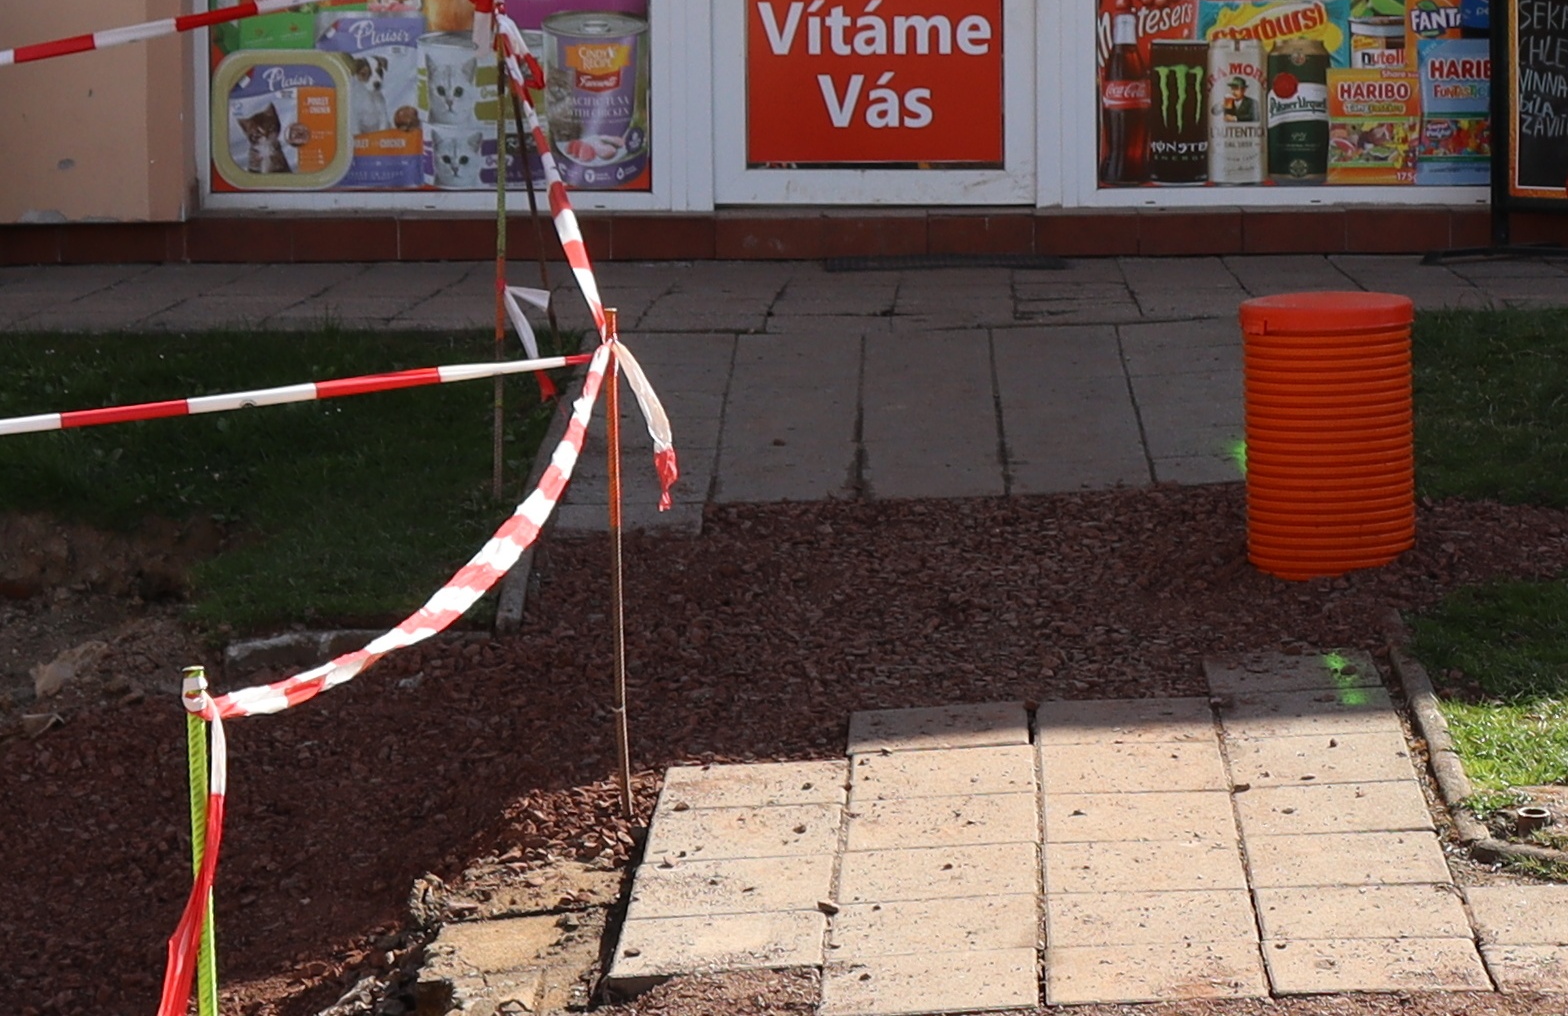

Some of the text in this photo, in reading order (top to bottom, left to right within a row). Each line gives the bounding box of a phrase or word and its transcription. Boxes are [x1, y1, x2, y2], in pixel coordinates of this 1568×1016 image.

[1362, 51, 1407, 64] nutell
[817, 71, 933, 128] Vás
[1339, 83, 1410, 100] HARIBO
